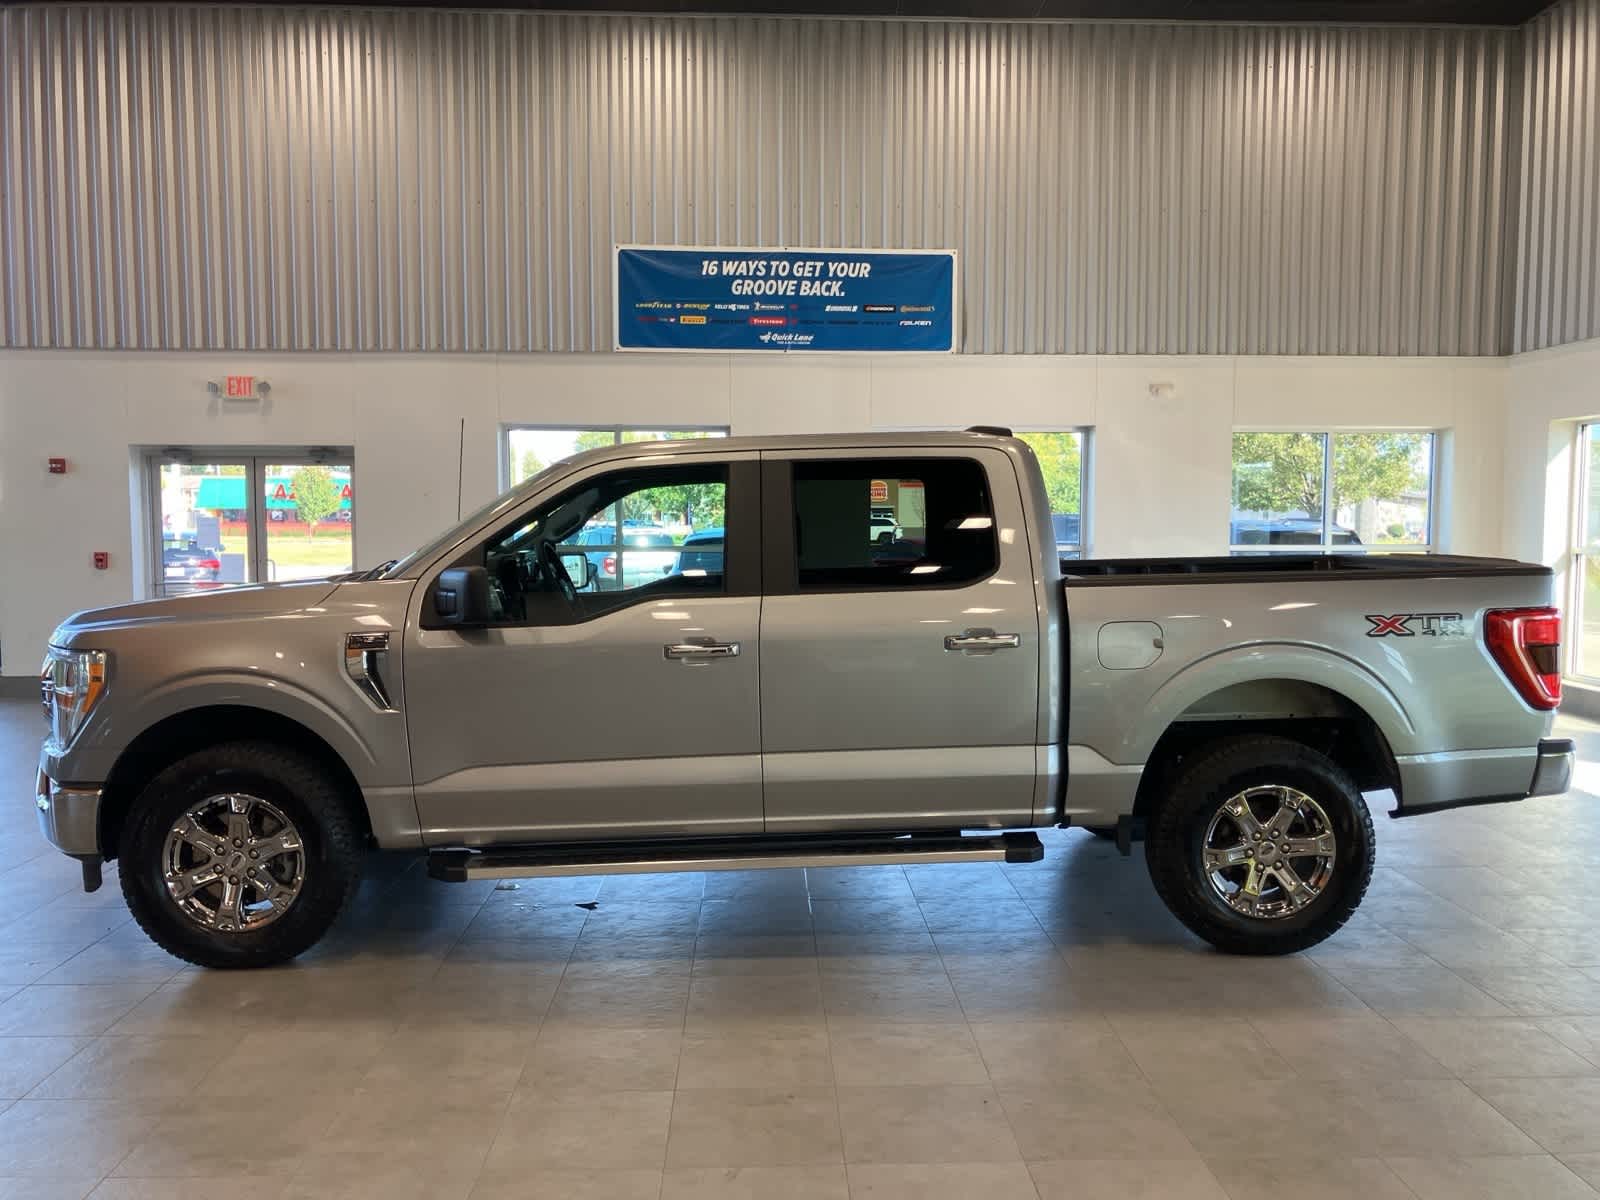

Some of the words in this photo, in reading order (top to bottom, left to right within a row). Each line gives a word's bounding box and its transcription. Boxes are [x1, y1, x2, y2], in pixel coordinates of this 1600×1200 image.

[701, 260, 719, 276] 16
[722, 260, 767, 276] WAYS
[770, 261, 790, 277] TO
[793, 261, 824, 277] GET
[828, 262, 871, 278] YOUR
[731, 279, 798, 296] GROOVE
[799, 280, 845, 297] BACK.
[771, 333, 794, 341] Quick
[793, 333, 815, 341] Lane
[227, 376, 254, 397] EXIT
